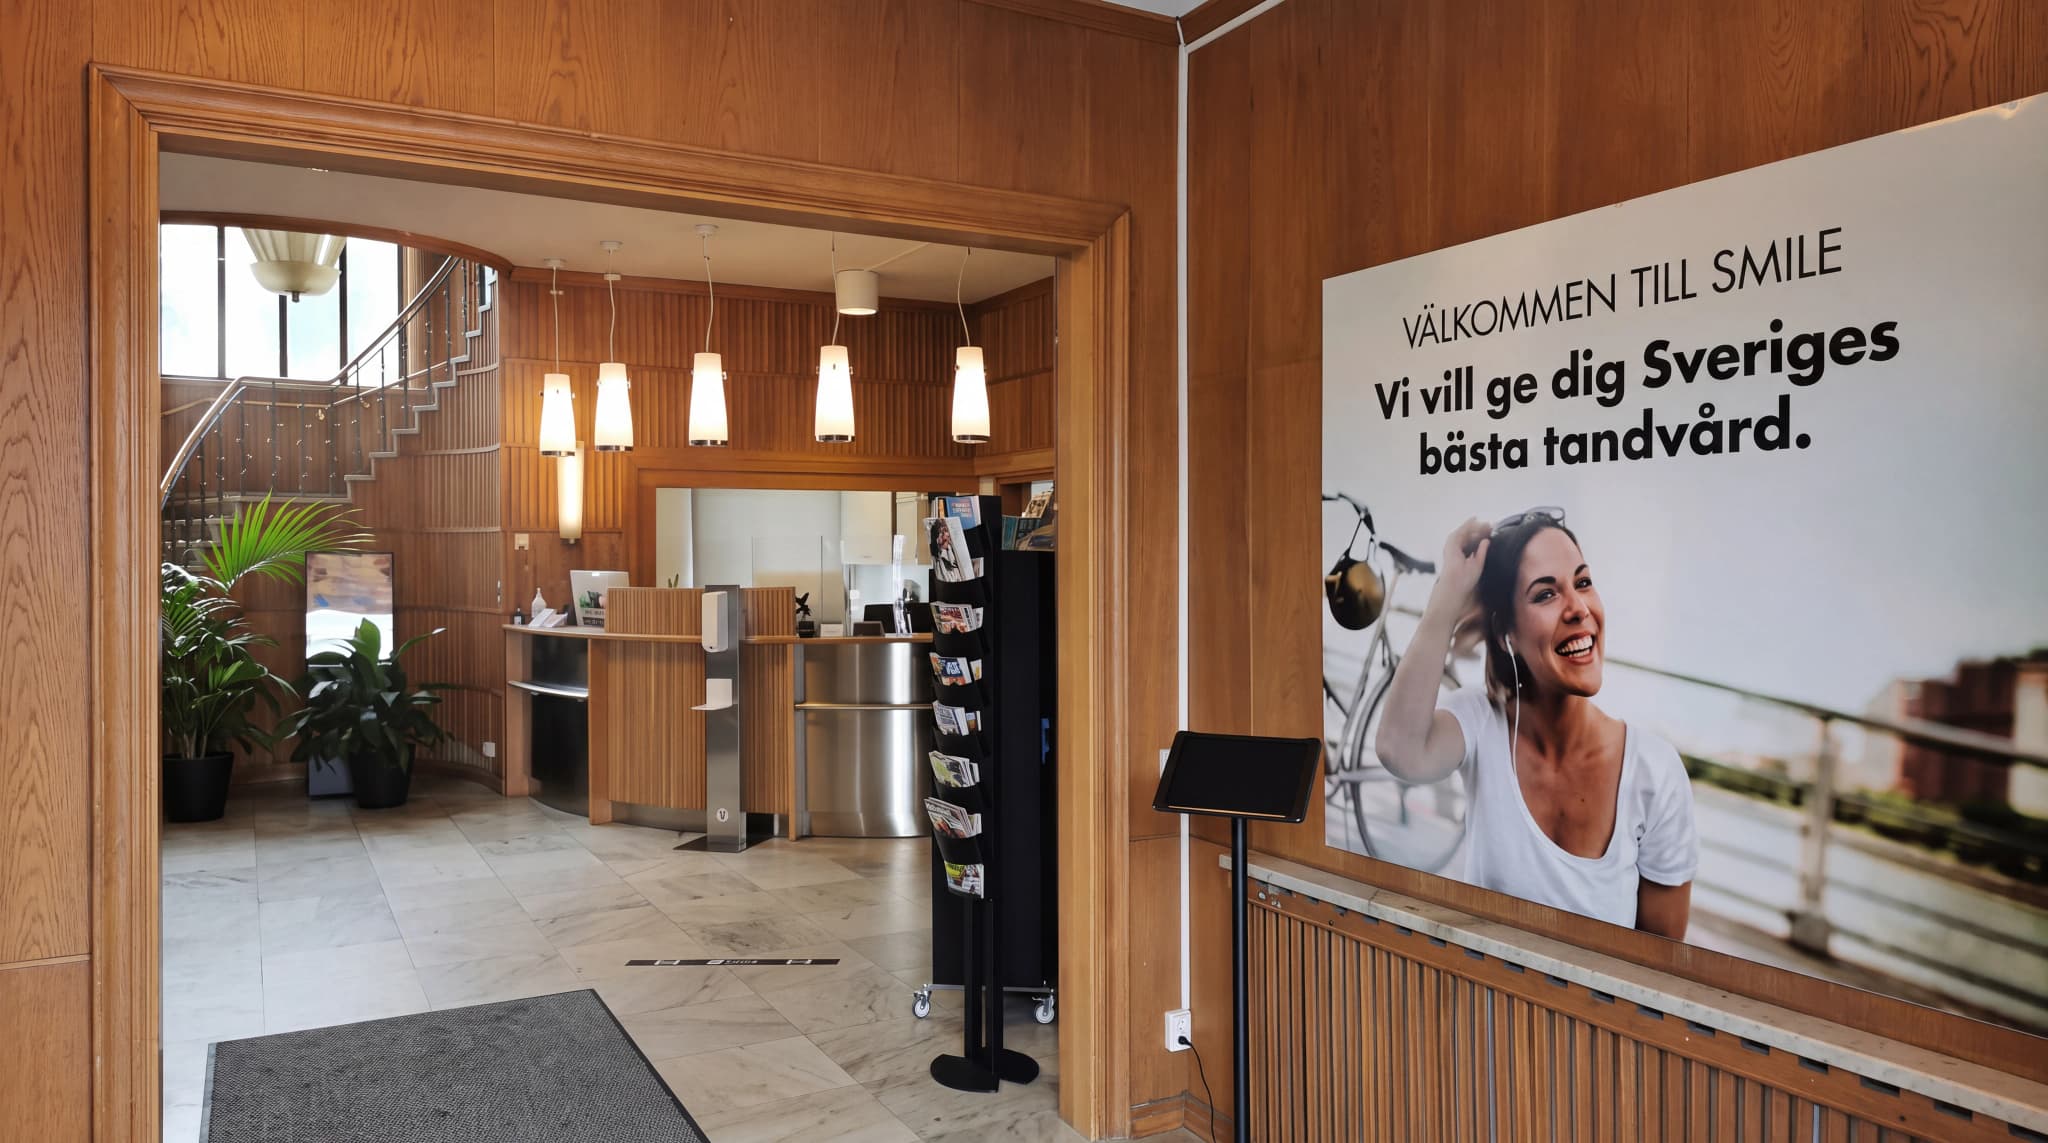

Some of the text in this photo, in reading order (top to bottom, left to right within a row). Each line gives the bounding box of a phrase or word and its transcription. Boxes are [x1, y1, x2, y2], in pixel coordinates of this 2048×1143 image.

[1403, 227, 1842, 349] VÄLKOMMEN TILL SMILE
[1375, 318, 1900, 420] Vi vill ge dig Sveriges
[1419, 394, 1812, 475] bästa tandvård.
